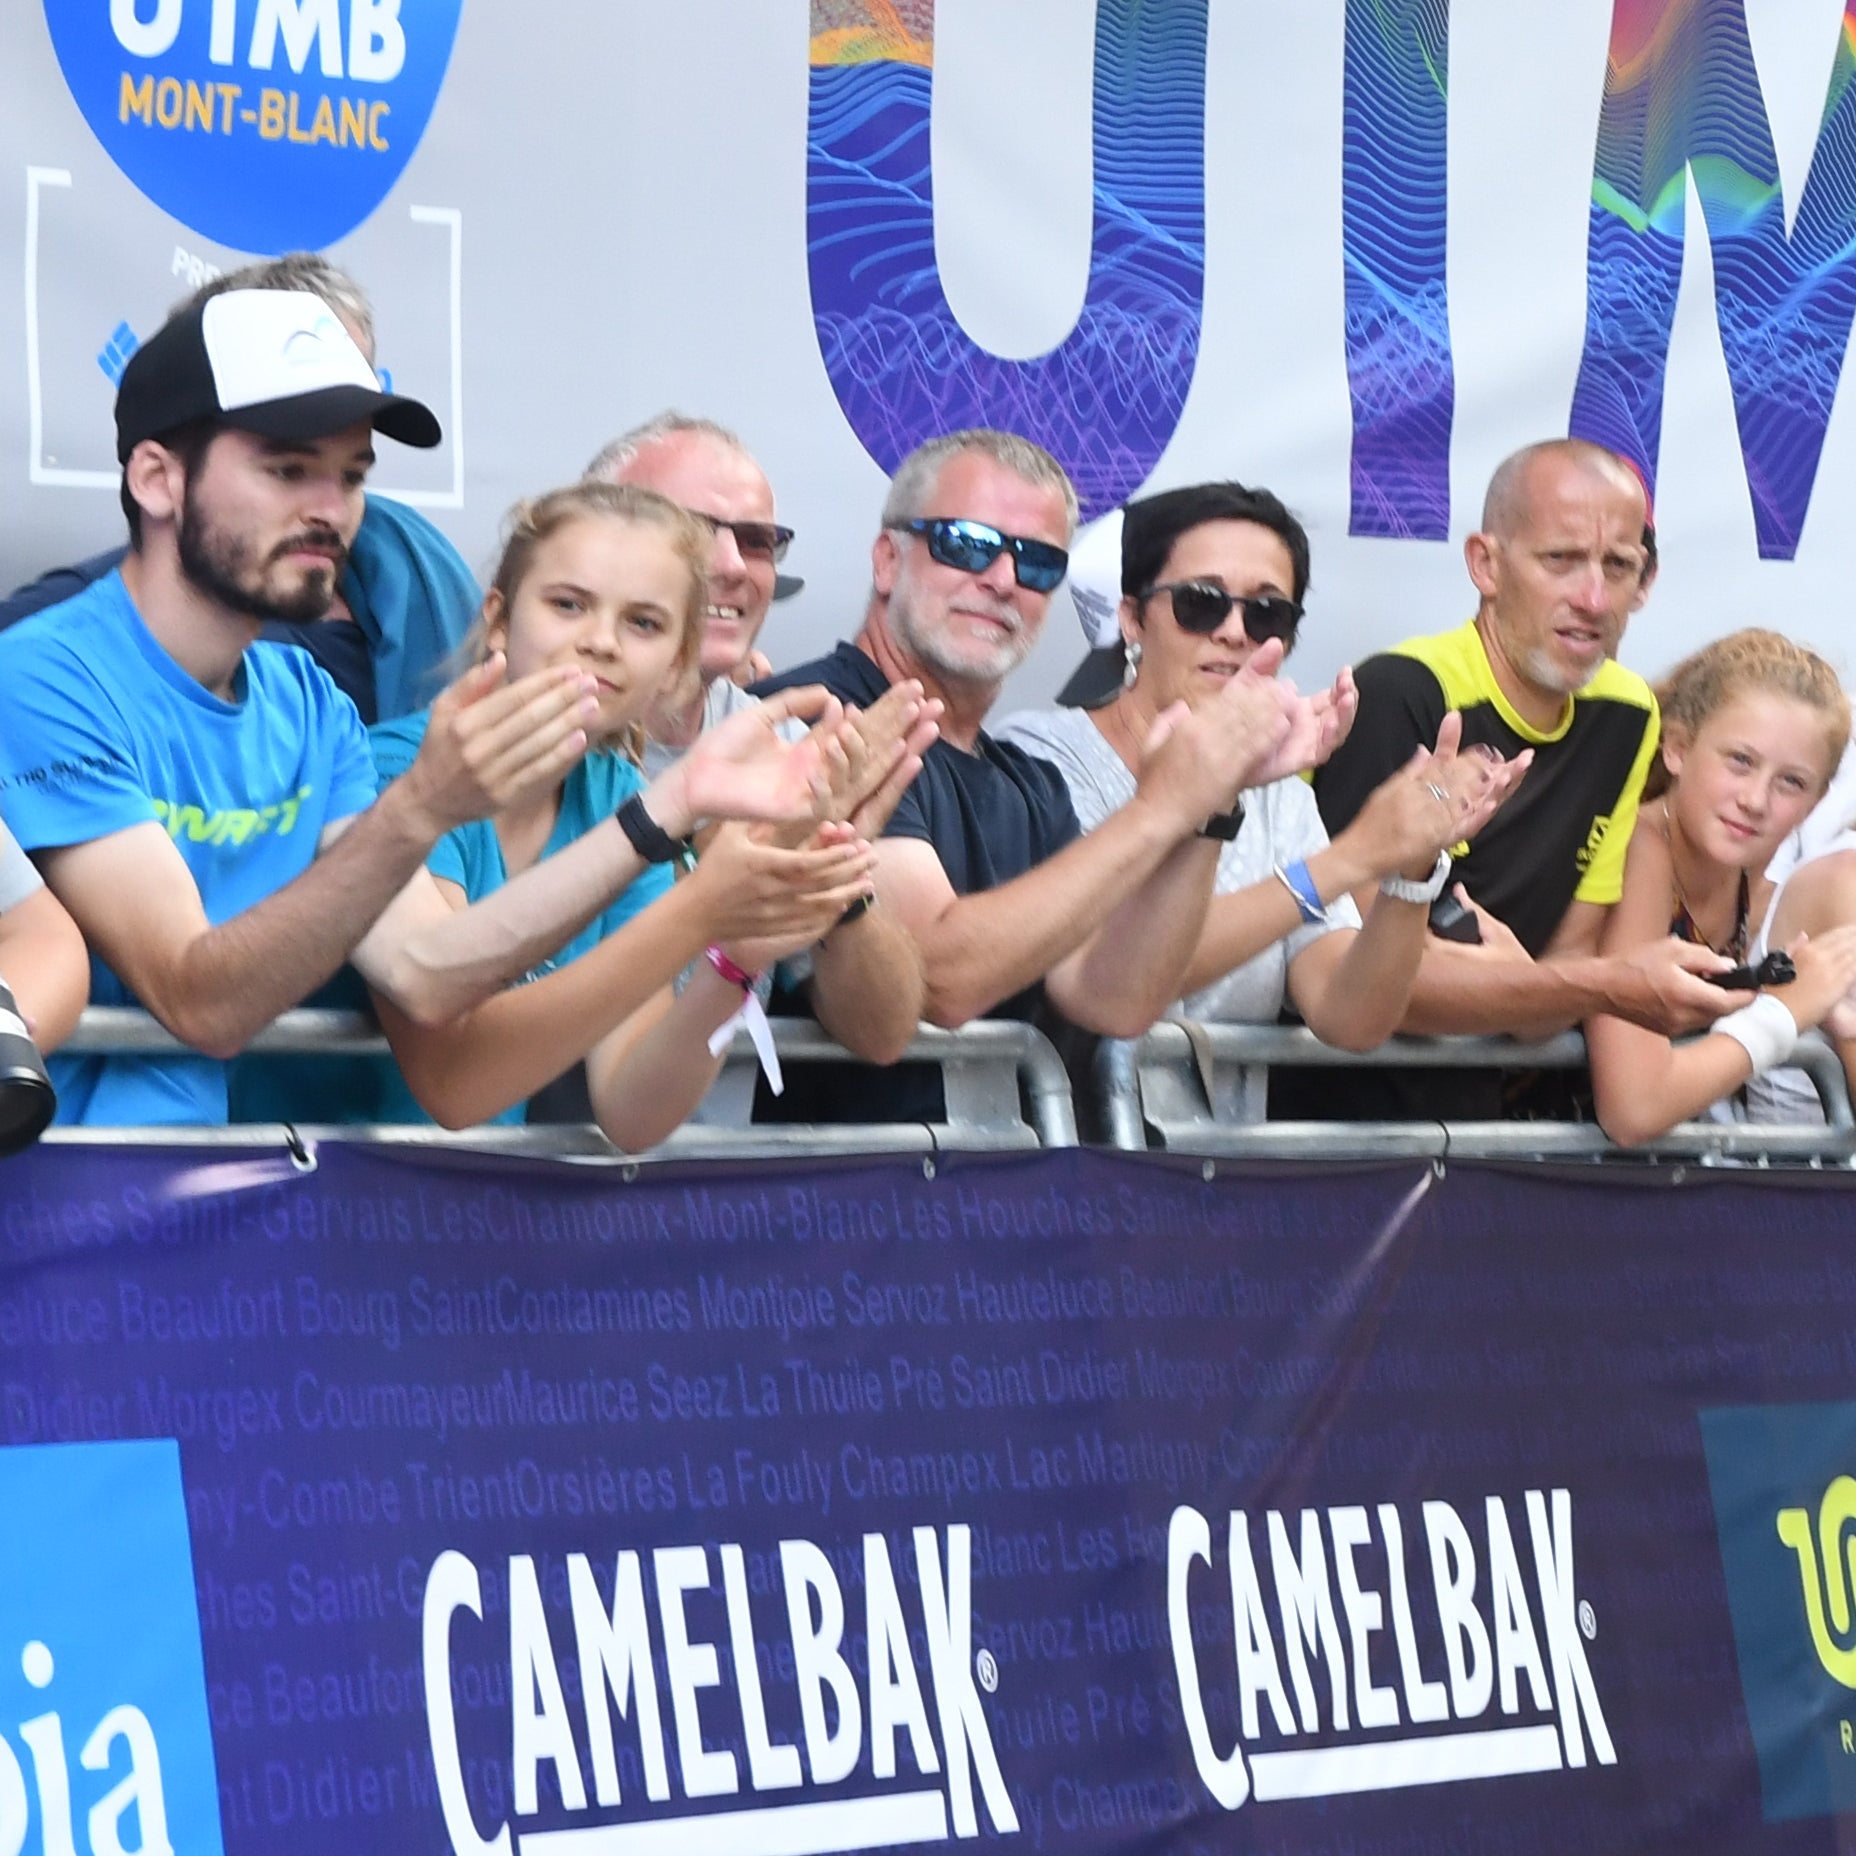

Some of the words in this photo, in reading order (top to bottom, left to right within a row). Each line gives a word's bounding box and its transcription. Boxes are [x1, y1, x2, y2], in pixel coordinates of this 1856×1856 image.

[117, 70, 391, 152] MONT-BLANC
[420, 1523, 1019, 1856] CAMELBAK
[1166, 1487, 1619, 1812] CAMELBAK
